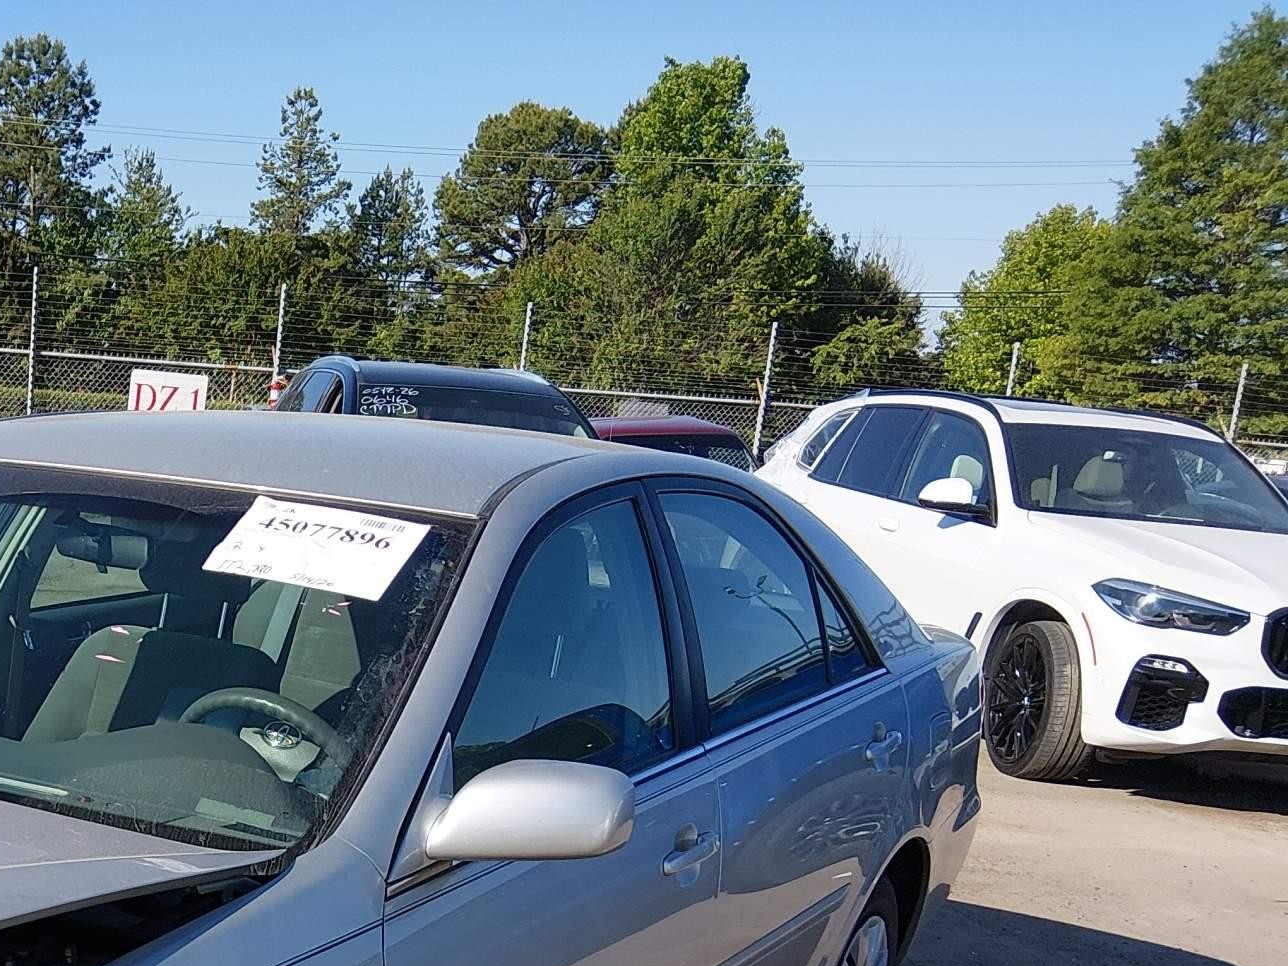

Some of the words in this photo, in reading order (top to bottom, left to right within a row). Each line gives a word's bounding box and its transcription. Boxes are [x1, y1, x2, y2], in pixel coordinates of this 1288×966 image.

[134, 383, 180, 411] DZ
[190, 388, 199, 411] 1
[361, 395, 409, 404] 0646
[259, 516, 394, 550] 45077896
